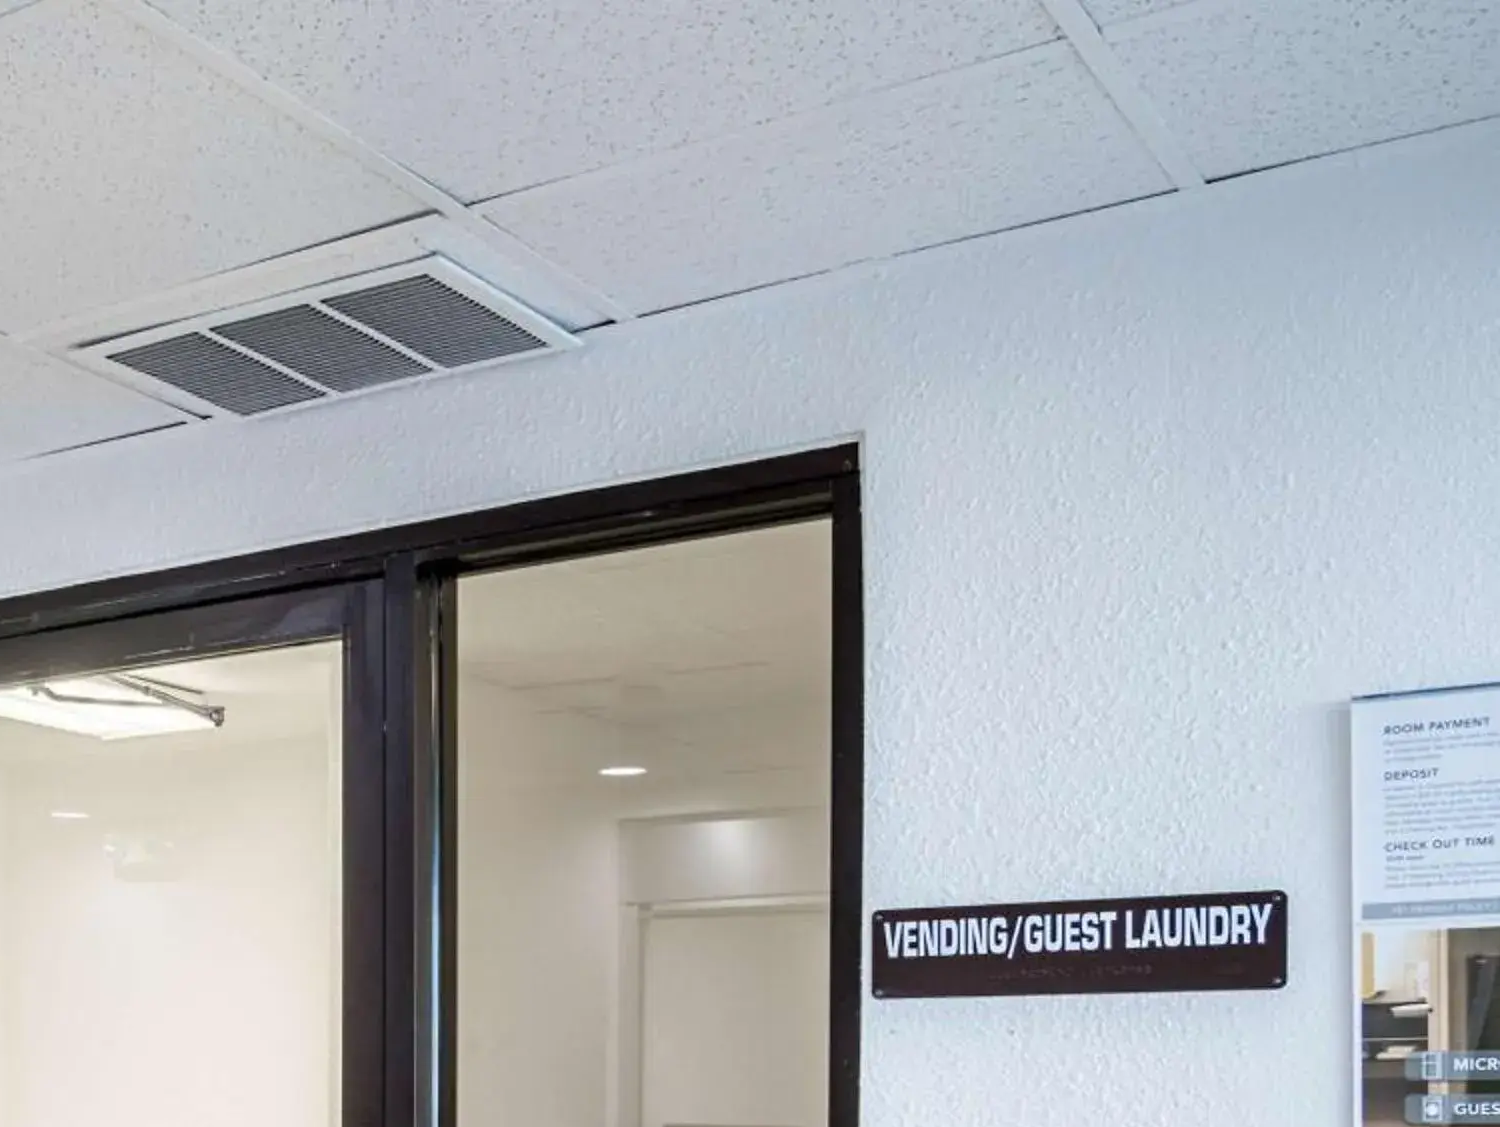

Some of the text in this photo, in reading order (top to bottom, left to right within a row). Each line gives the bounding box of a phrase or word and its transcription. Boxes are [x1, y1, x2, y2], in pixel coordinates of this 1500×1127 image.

[1382, 716, 1491, 735] ROOM PAYMENT
[1383, 767, 1439, 782] DEPOSIT
[1383, 834, 1495, 853] CHECK OUT TIME
[883, 903, 1273, 960] VENDING/GUEST LAUNDRY
[1453, 1057, 1500, 1072] MICR
